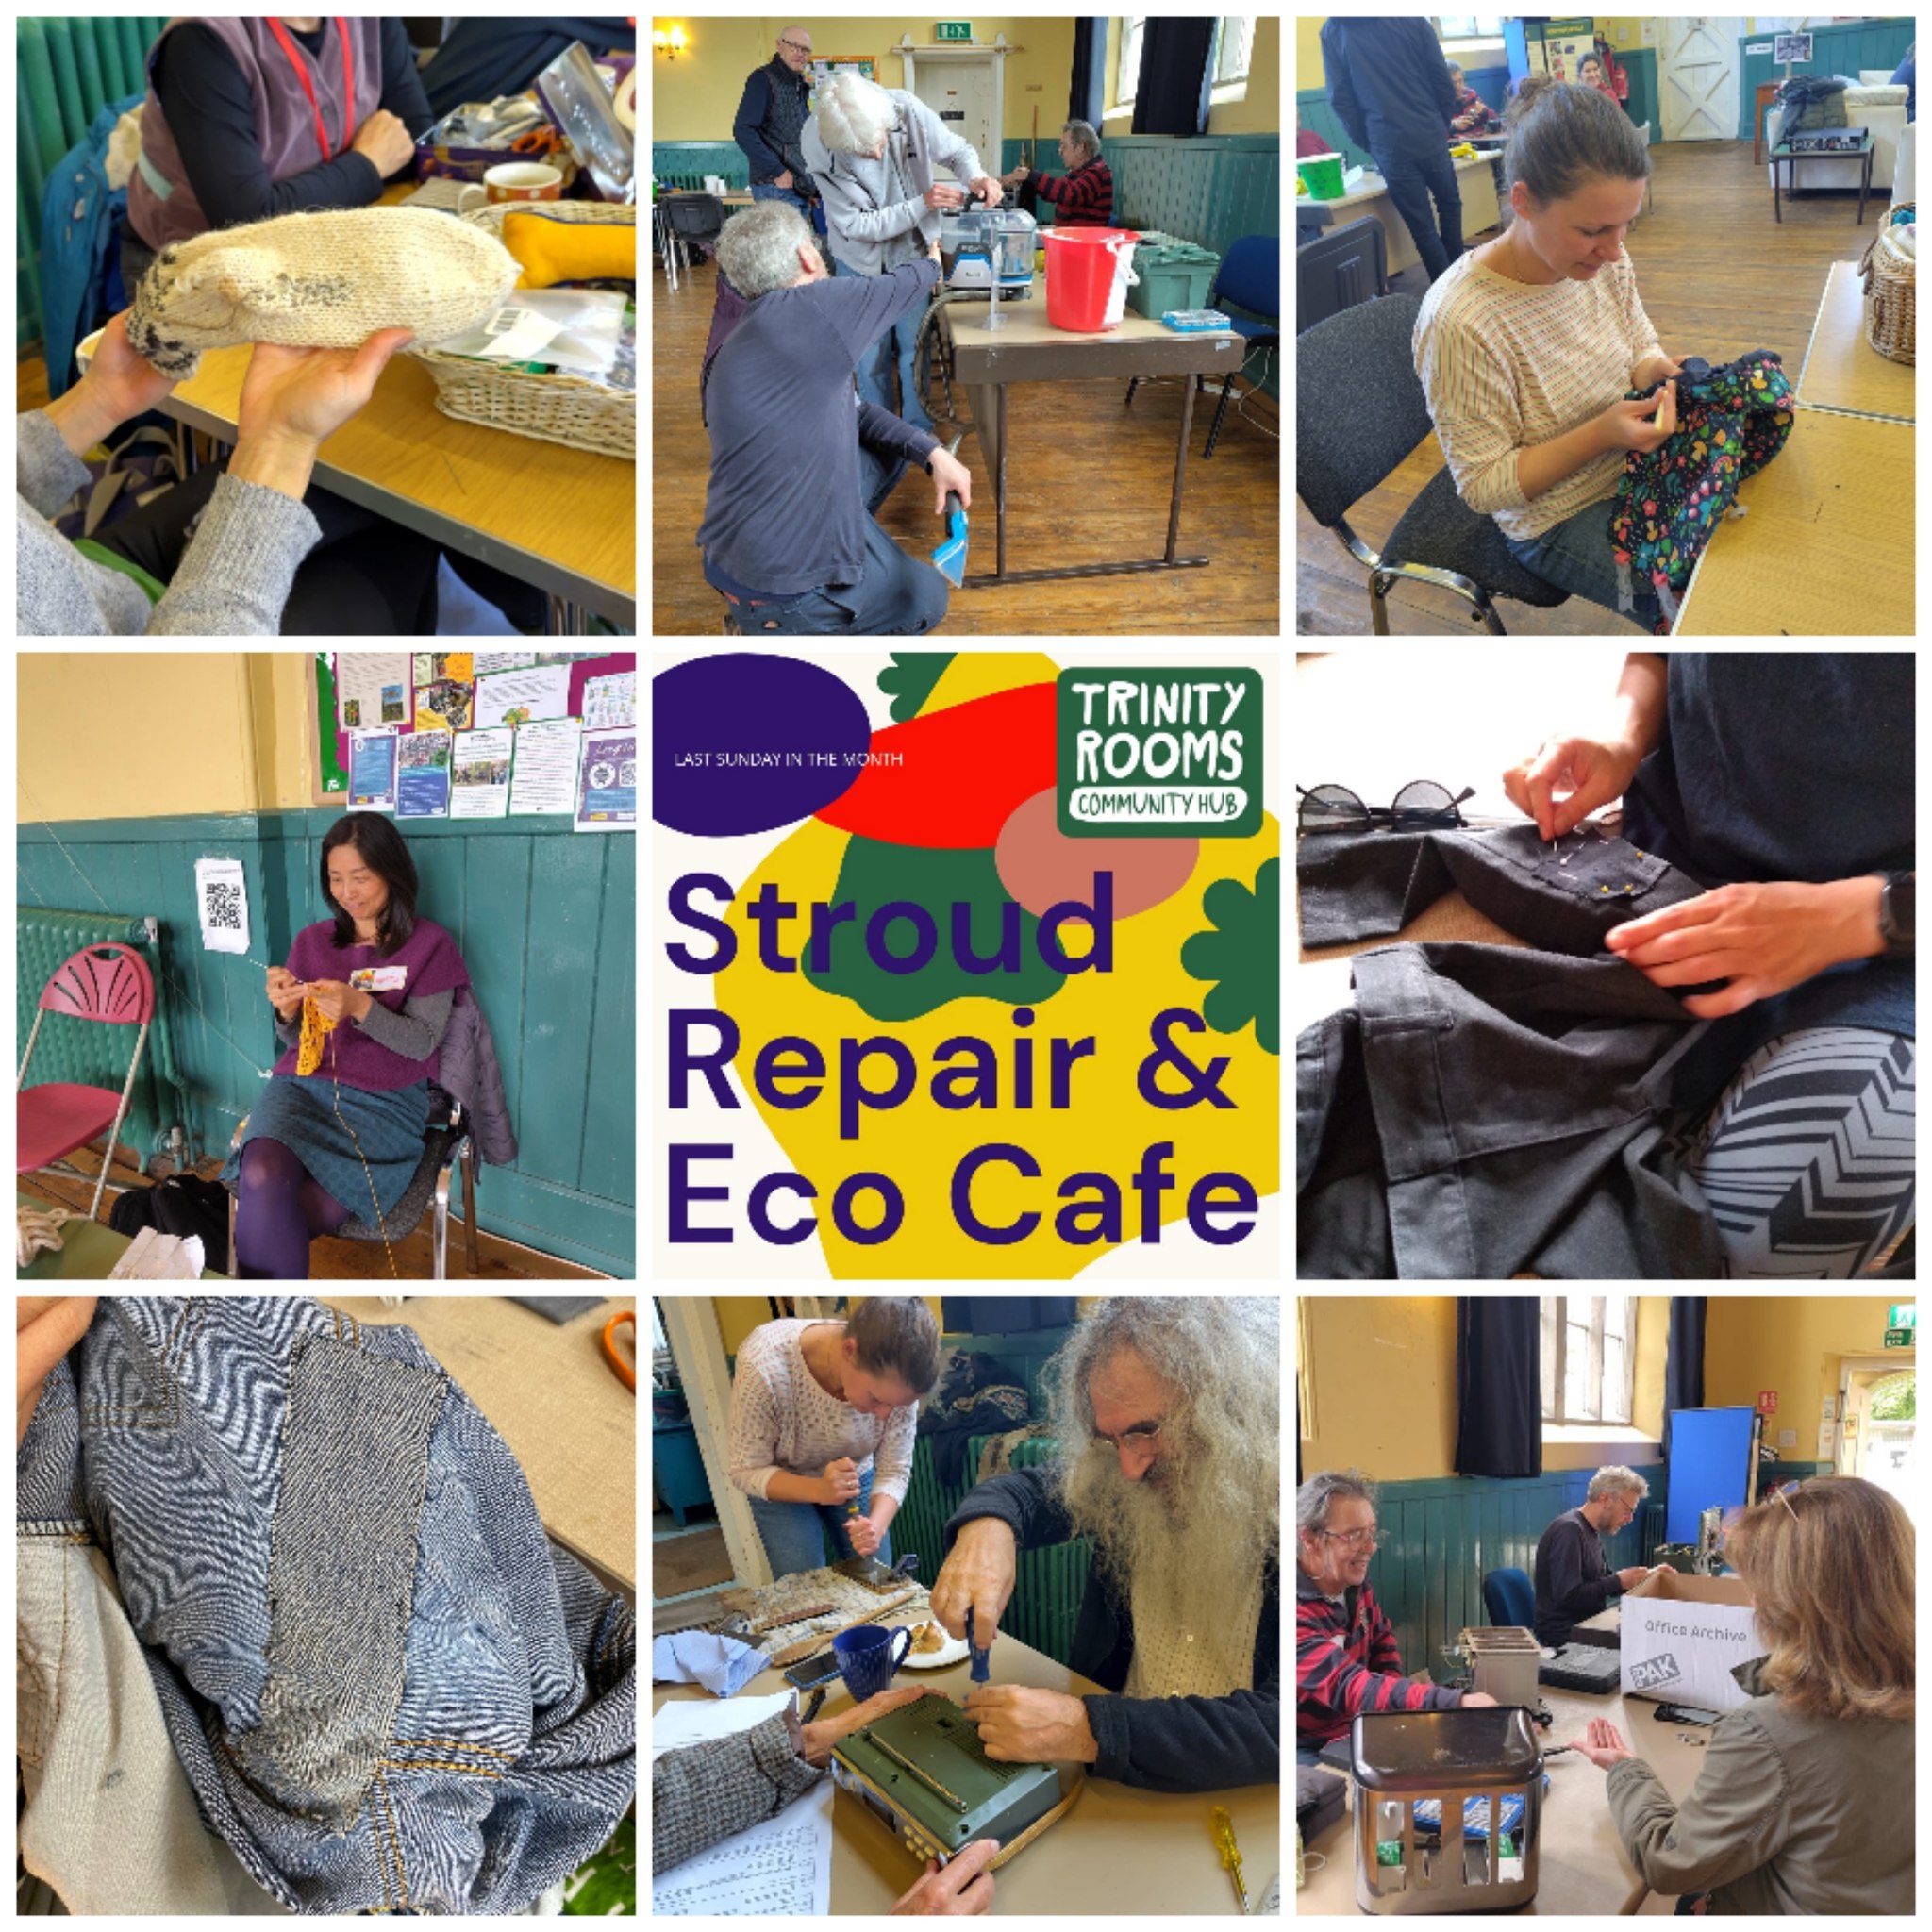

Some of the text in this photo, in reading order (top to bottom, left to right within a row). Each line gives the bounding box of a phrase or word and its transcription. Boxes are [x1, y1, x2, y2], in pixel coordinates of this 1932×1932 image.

[1072, 680, 1246, 727] TRINITY
[675, 753, 903, 767] LAST SUNDAY IN THE MONTH
[1076, 730, 1244, 783] ROOMS
[1078, 792, 1239, 817] COMMUNITY HUB
[665, 871, 1114, 975] Stroud
[668, 1008, 1239, 1140] Repair &
[668, 1141, 1259, 1245] Eco Cafe
[1645, 1619, 1747, 1641] Office Archive
